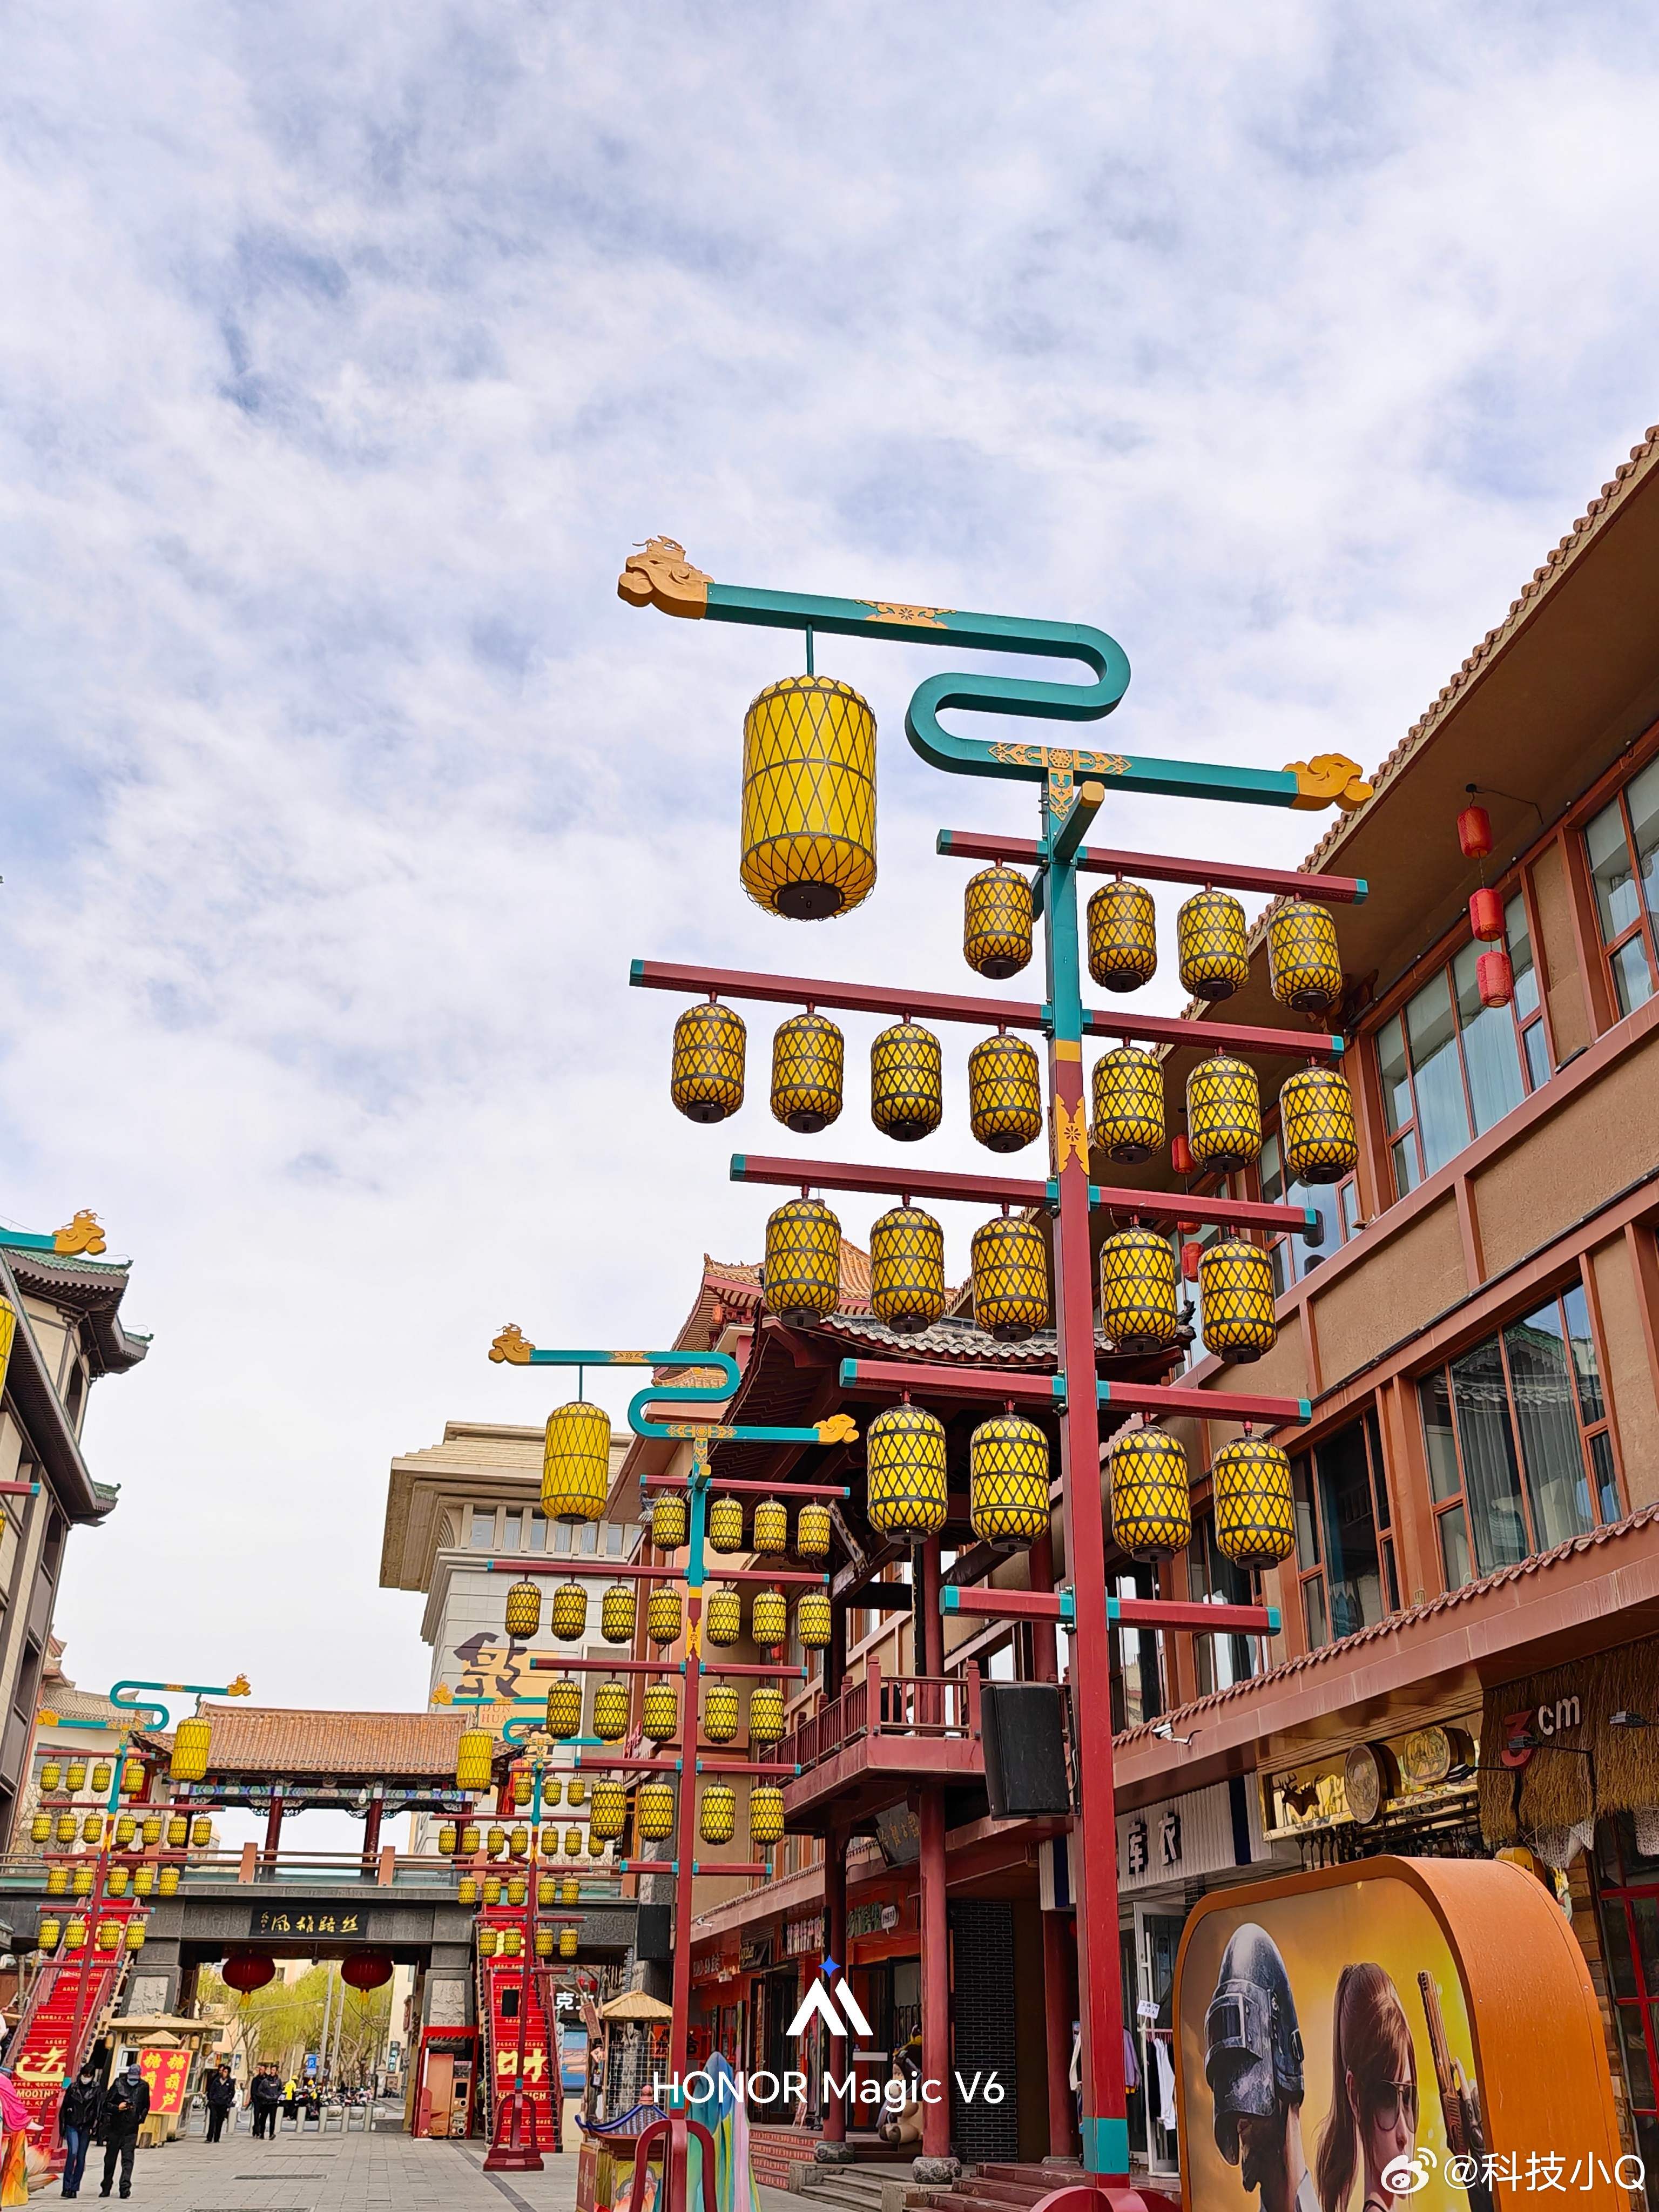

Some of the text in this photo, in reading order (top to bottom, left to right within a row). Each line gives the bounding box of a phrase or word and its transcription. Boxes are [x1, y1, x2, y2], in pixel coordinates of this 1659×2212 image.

[482, 1714, 517, 1725] HUA
[158, 2053, 186, 2111] 糖葫芦
